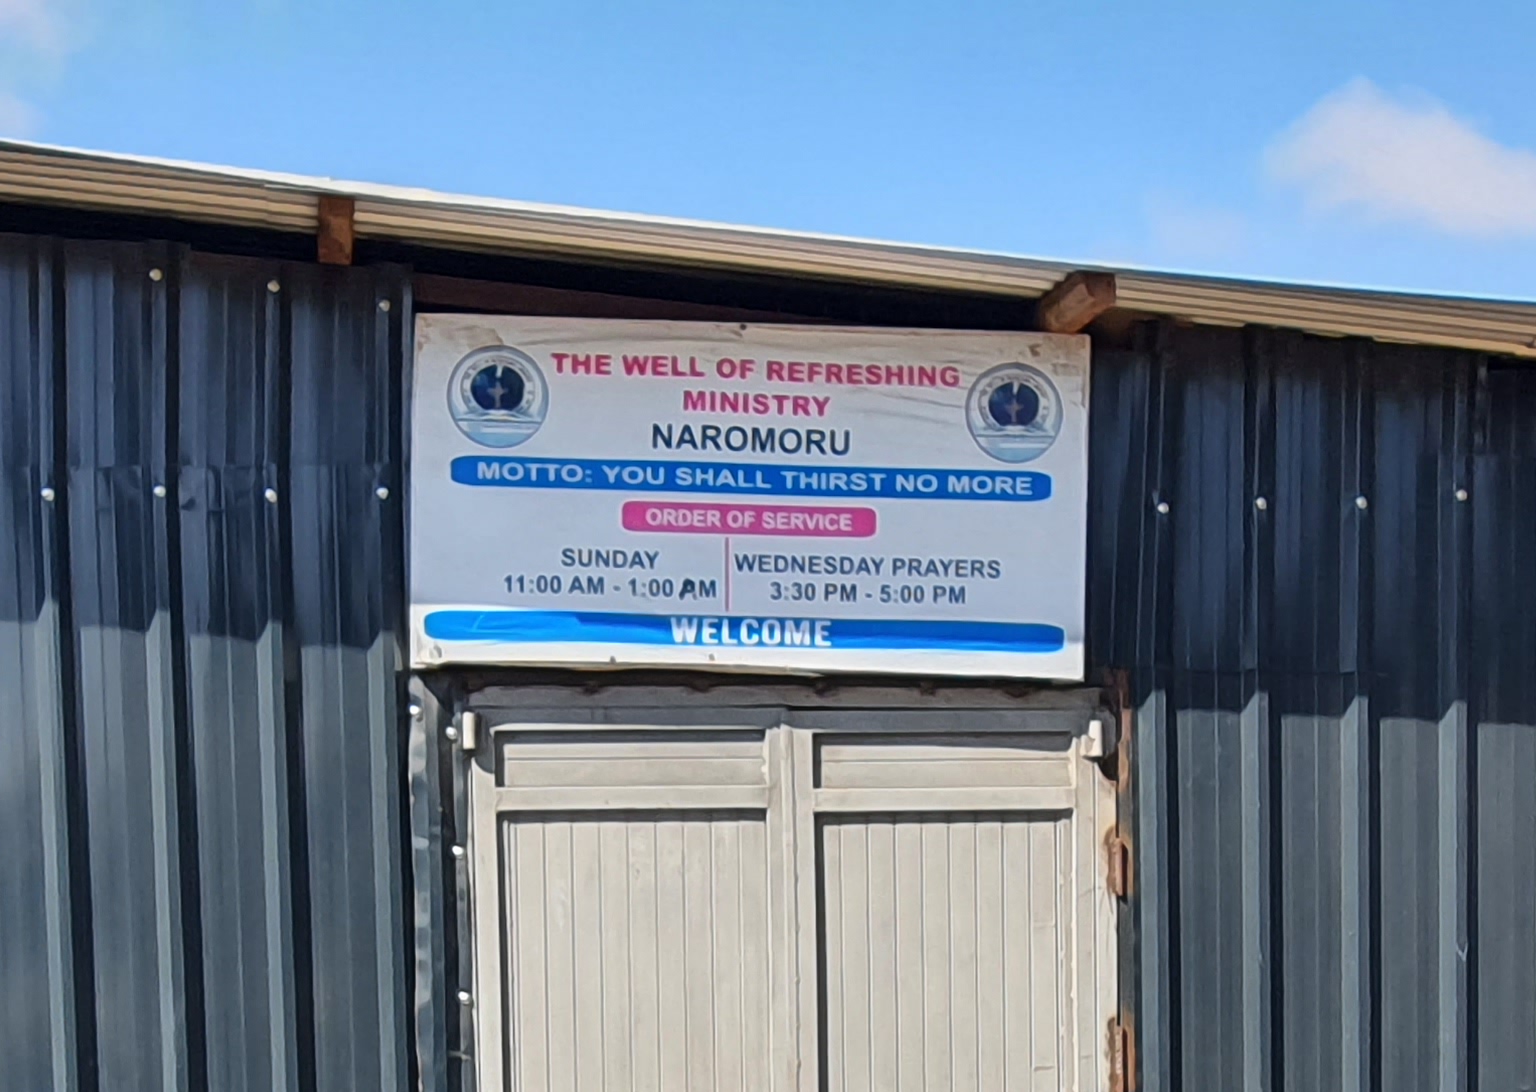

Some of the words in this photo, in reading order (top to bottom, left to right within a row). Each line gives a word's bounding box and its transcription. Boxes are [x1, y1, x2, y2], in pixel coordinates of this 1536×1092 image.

[551, 353, 611, 376] THE
[622, 356, 705, 378] WELL
[716, 358, 755, 380] OF
[766, 361, 960, 388] REFRESHING
[683, 390, 830, 417] MINISTRY
[651, 423, 852, 457] NAROMORU
[477, 462, 592, 484] MOTTO:
[603, 466, 665, 486] YOU
[675, 468, 771, 489] SHALL
[781, 471, 887, 493] THIRST
[895, 475, 939, 493] NO
[948, 476, 1032, 495] MORE
[645, 507, 721, 528] ORDER
[726, 510, 755, 529] OF
[762, 511, 853, 532] SERVICE
[560, 548, 660, 570] SUNDAY
[734, 553, 885, 577] WEDNESDAY
[891, 557, 1001, 580] PRAYERS
[503, 574, 563, 594] 11:00
[567, 575, 605, 595] AM
[628, 577, 675, 598] 1:00
[769, 580, 817, 602] 3:30
[823, 582, 858, 602] PM
[879, 583, 926, 604] 5:00
[931, 584, 967, 604] PM
[670, 617, 833, 647] WELCOME
